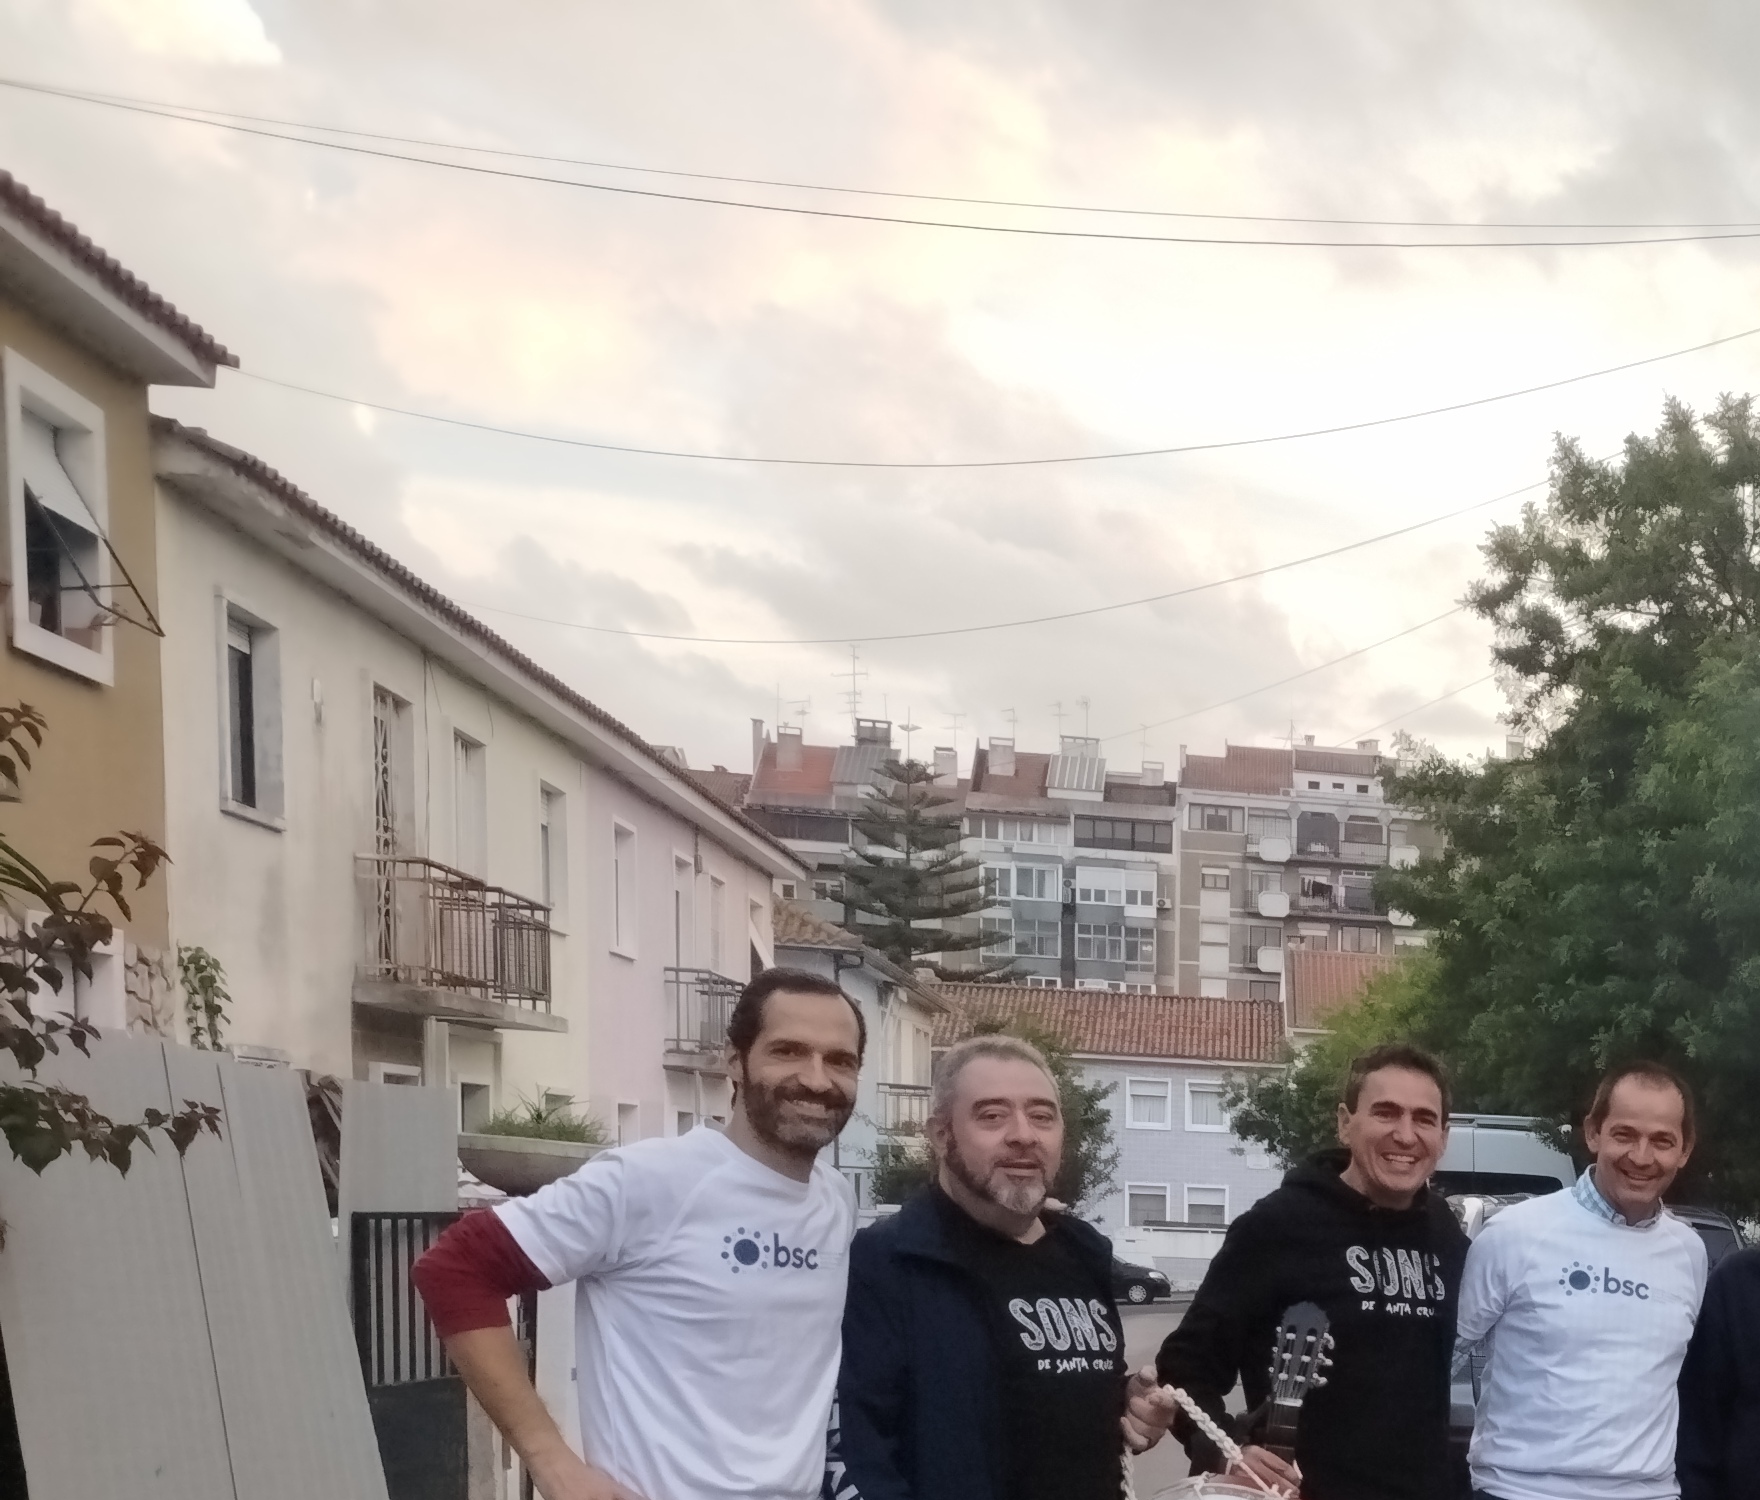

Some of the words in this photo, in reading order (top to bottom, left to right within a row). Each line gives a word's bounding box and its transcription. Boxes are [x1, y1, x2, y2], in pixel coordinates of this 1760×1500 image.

[773, 1232, 819, 1270] bsc
[1346, 1246, 1446, 1300] SONS
[1603, 1266, 1649, 1300] bsc
[1008, 1297, 1118, 1352] SONS
[1361, 1301, 1376, 1311] DE
[1385, 1302, 1412, 1316] ANTA
[1416, 1306, 1435, 1318] CRU
[1038, 1359, 1051, 1371] DE
[1056, 1357, 1089, 1374] SANTA
